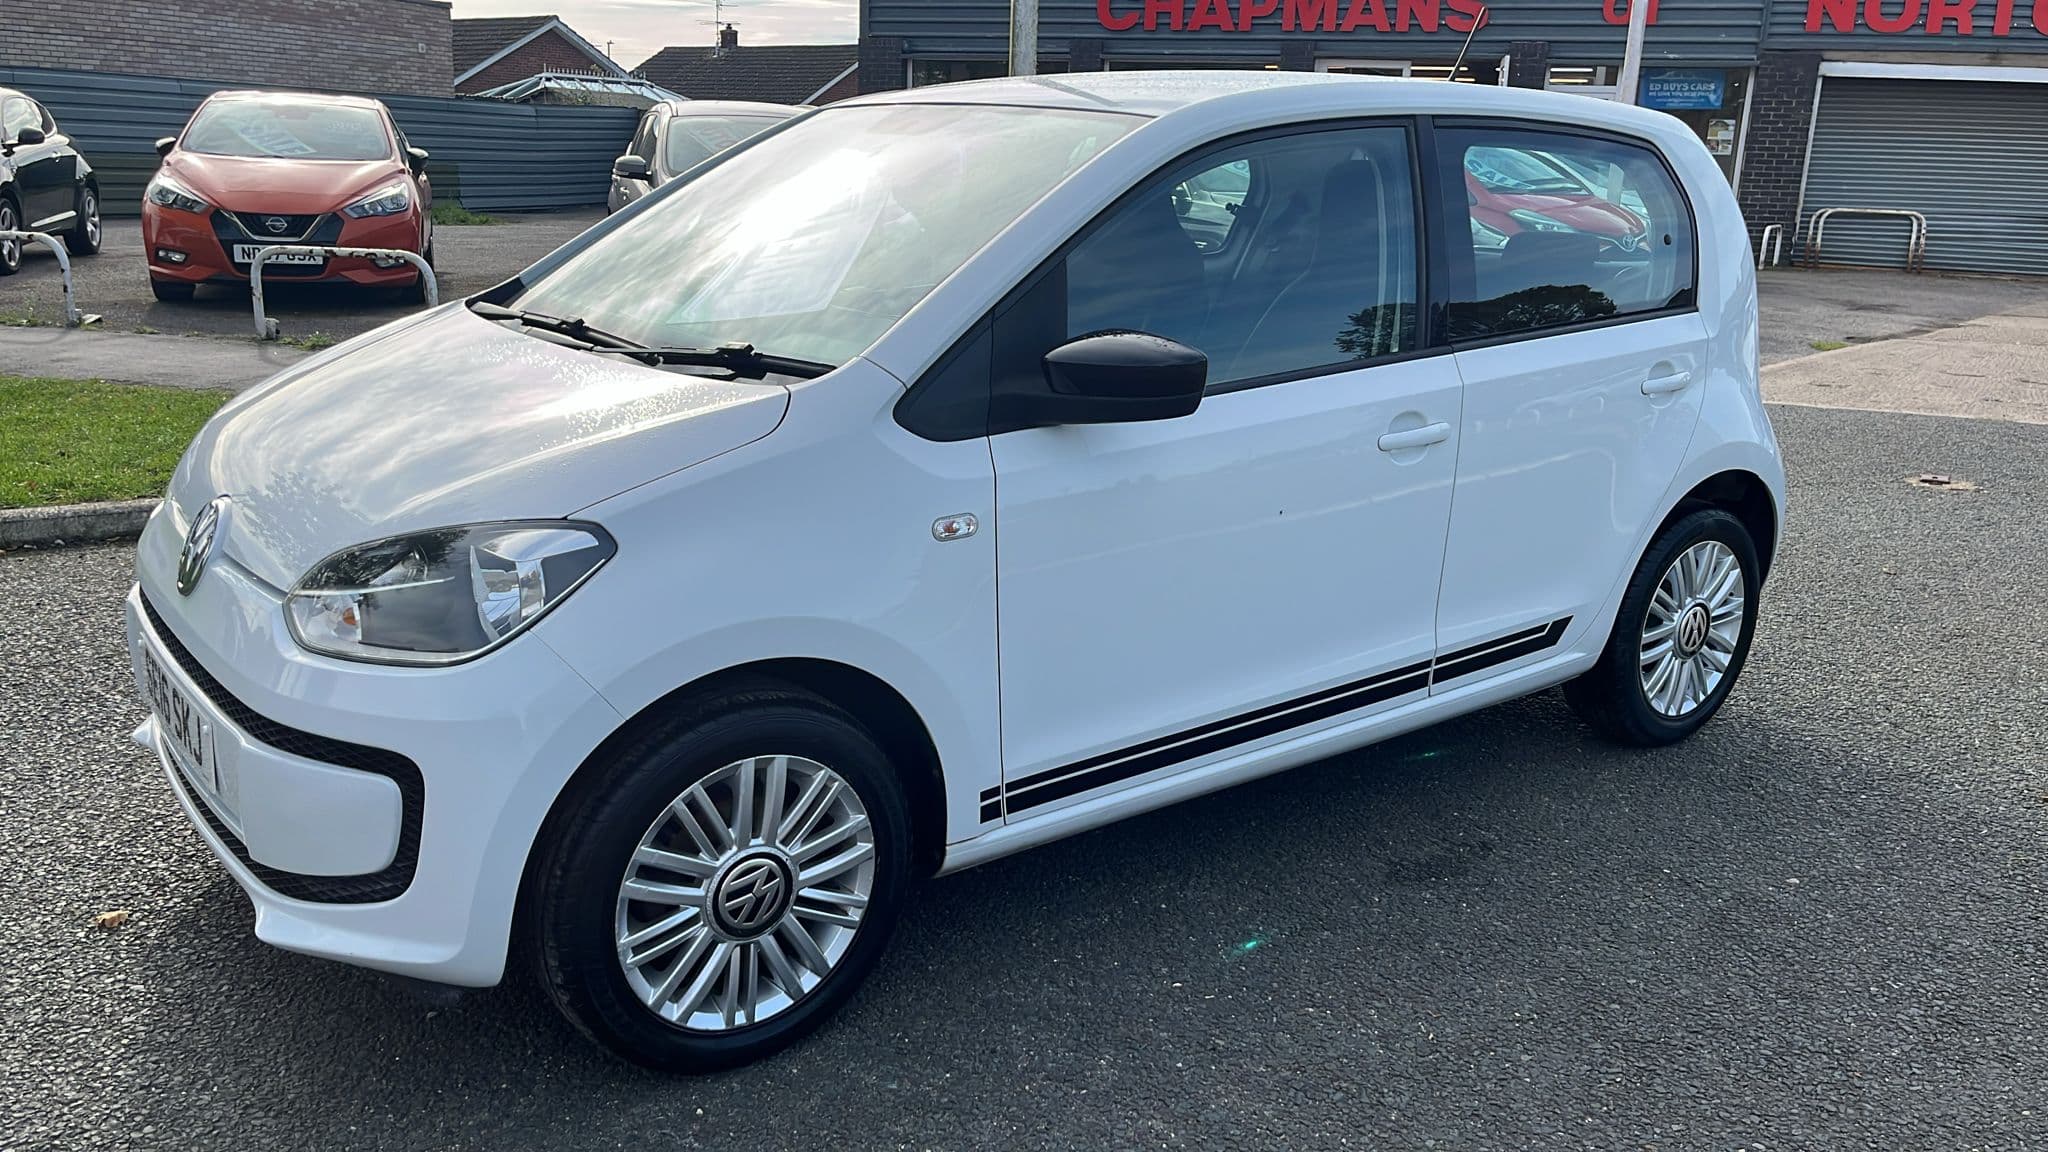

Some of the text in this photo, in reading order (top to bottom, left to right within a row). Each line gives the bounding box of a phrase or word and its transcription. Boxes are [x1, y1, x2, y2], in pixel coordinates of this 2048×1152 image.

[1097, 0, 1489, 32] CHAPMANS
[1804, 0, 2048, 36] NORT
[1663, 82, 1689, 91] BUYS
[1690, 82, 1716, 91] CARS
[172, 687, 203, 767] SKJ
